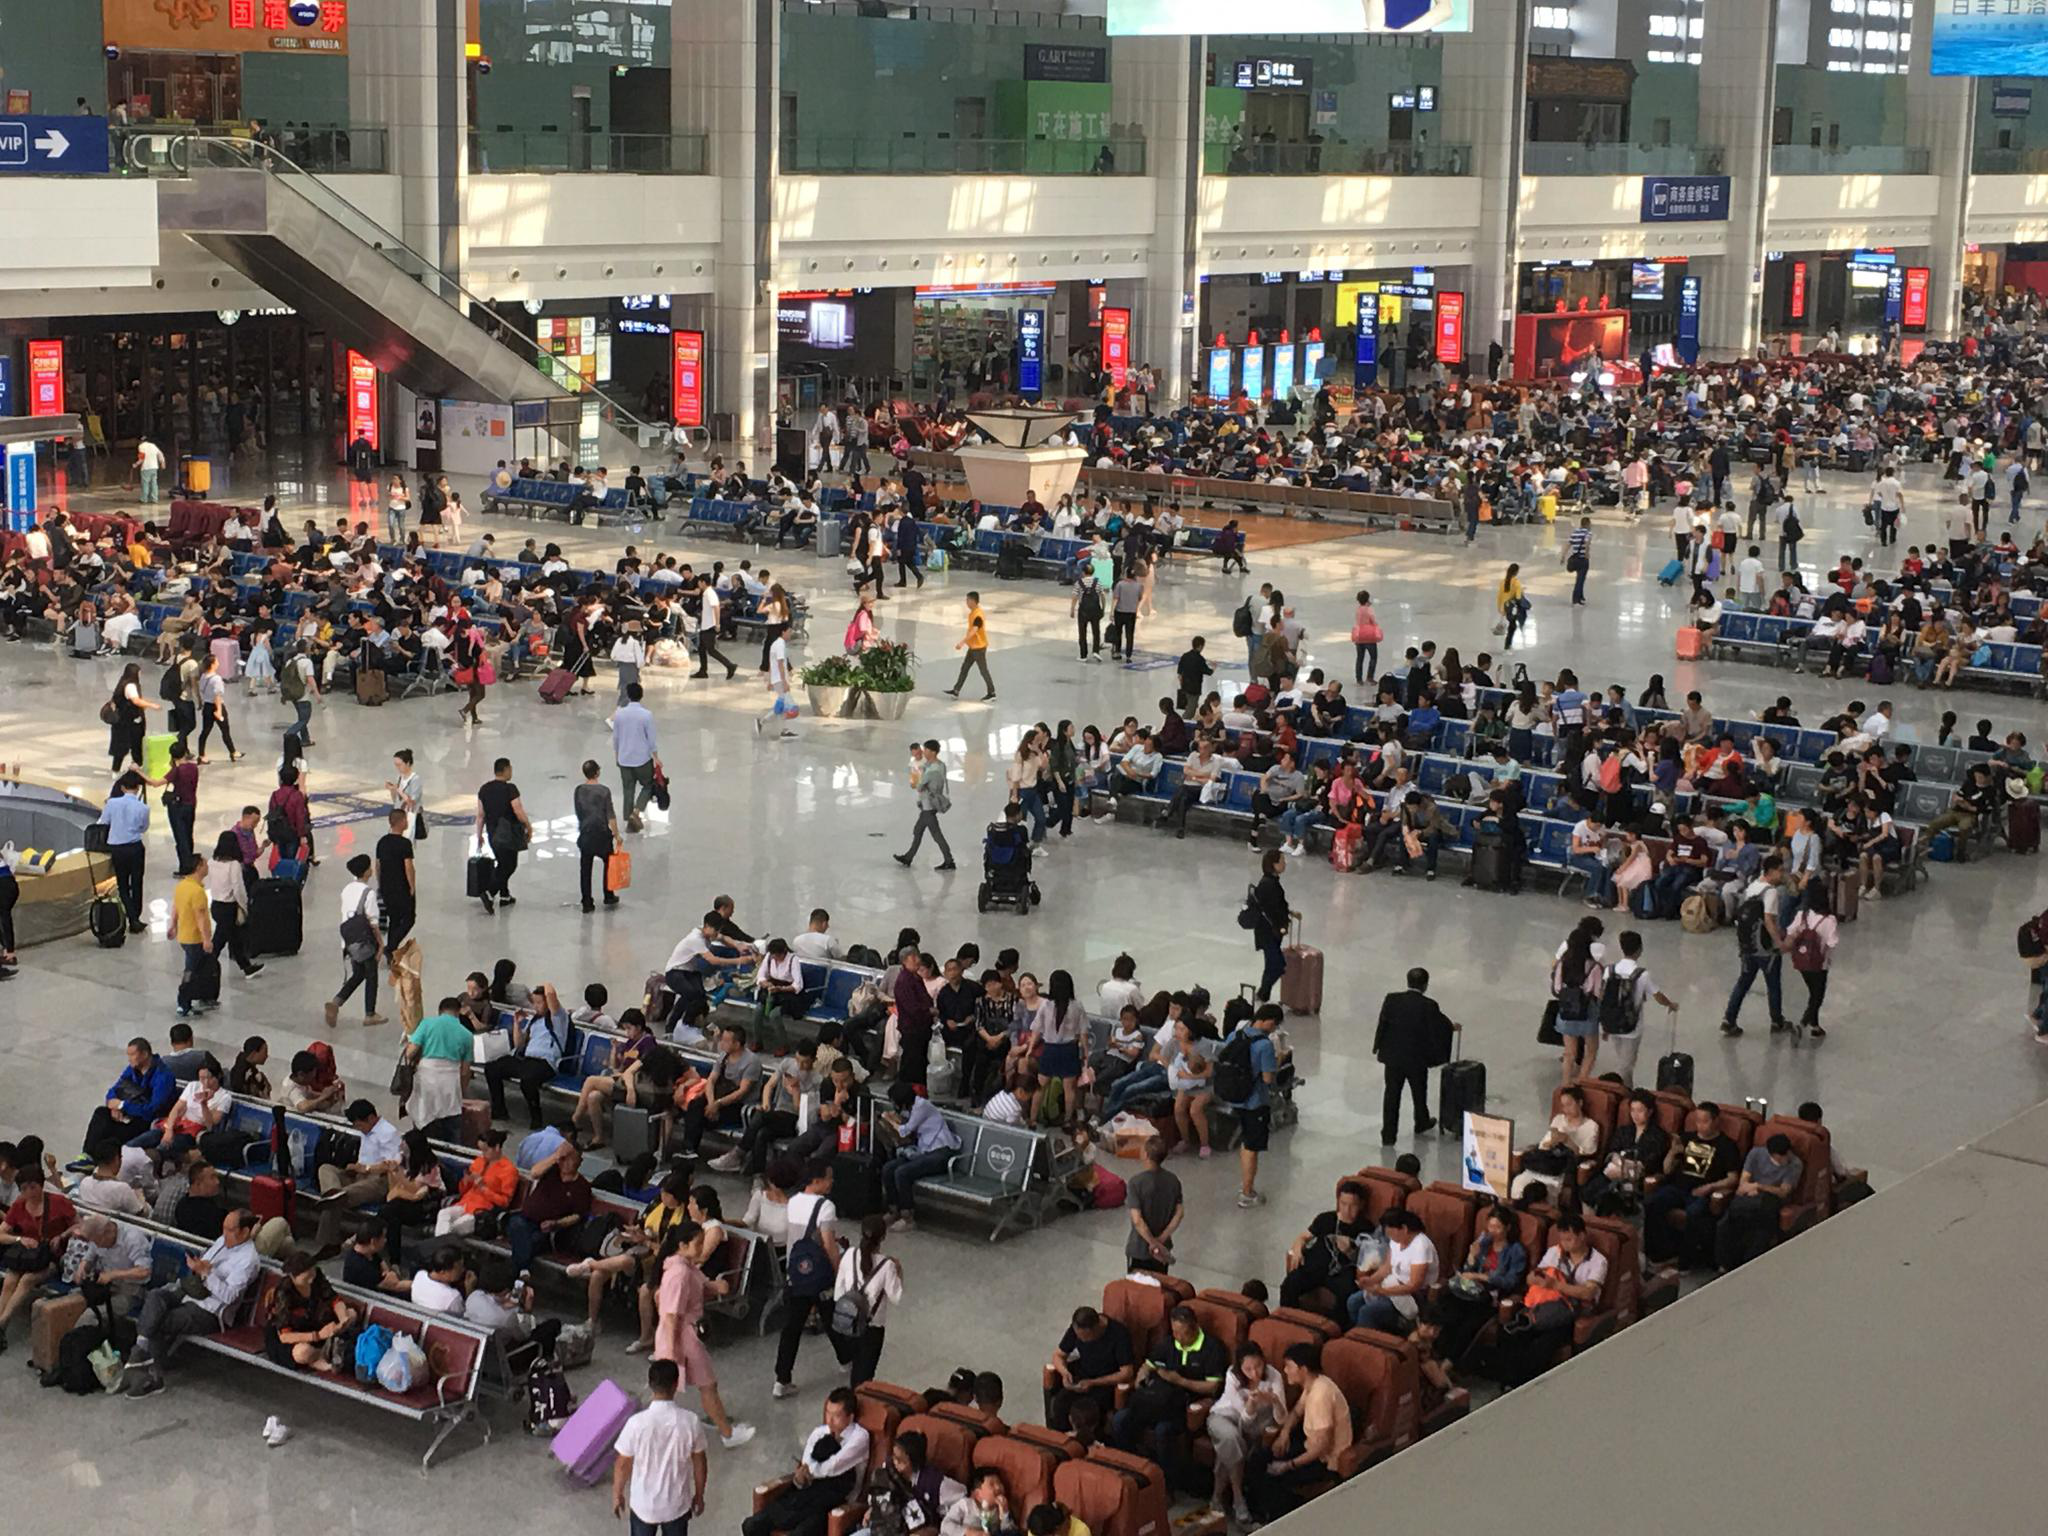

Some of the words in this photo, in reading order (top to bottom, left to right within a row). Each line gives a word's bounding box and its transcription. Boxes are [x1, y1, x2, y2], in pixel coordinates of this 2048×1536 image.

[321, 1, 345, 33] 茅
[0, 136, 23, 151] VIP
[1670, 184, 1720, 203] 商务座候车区
